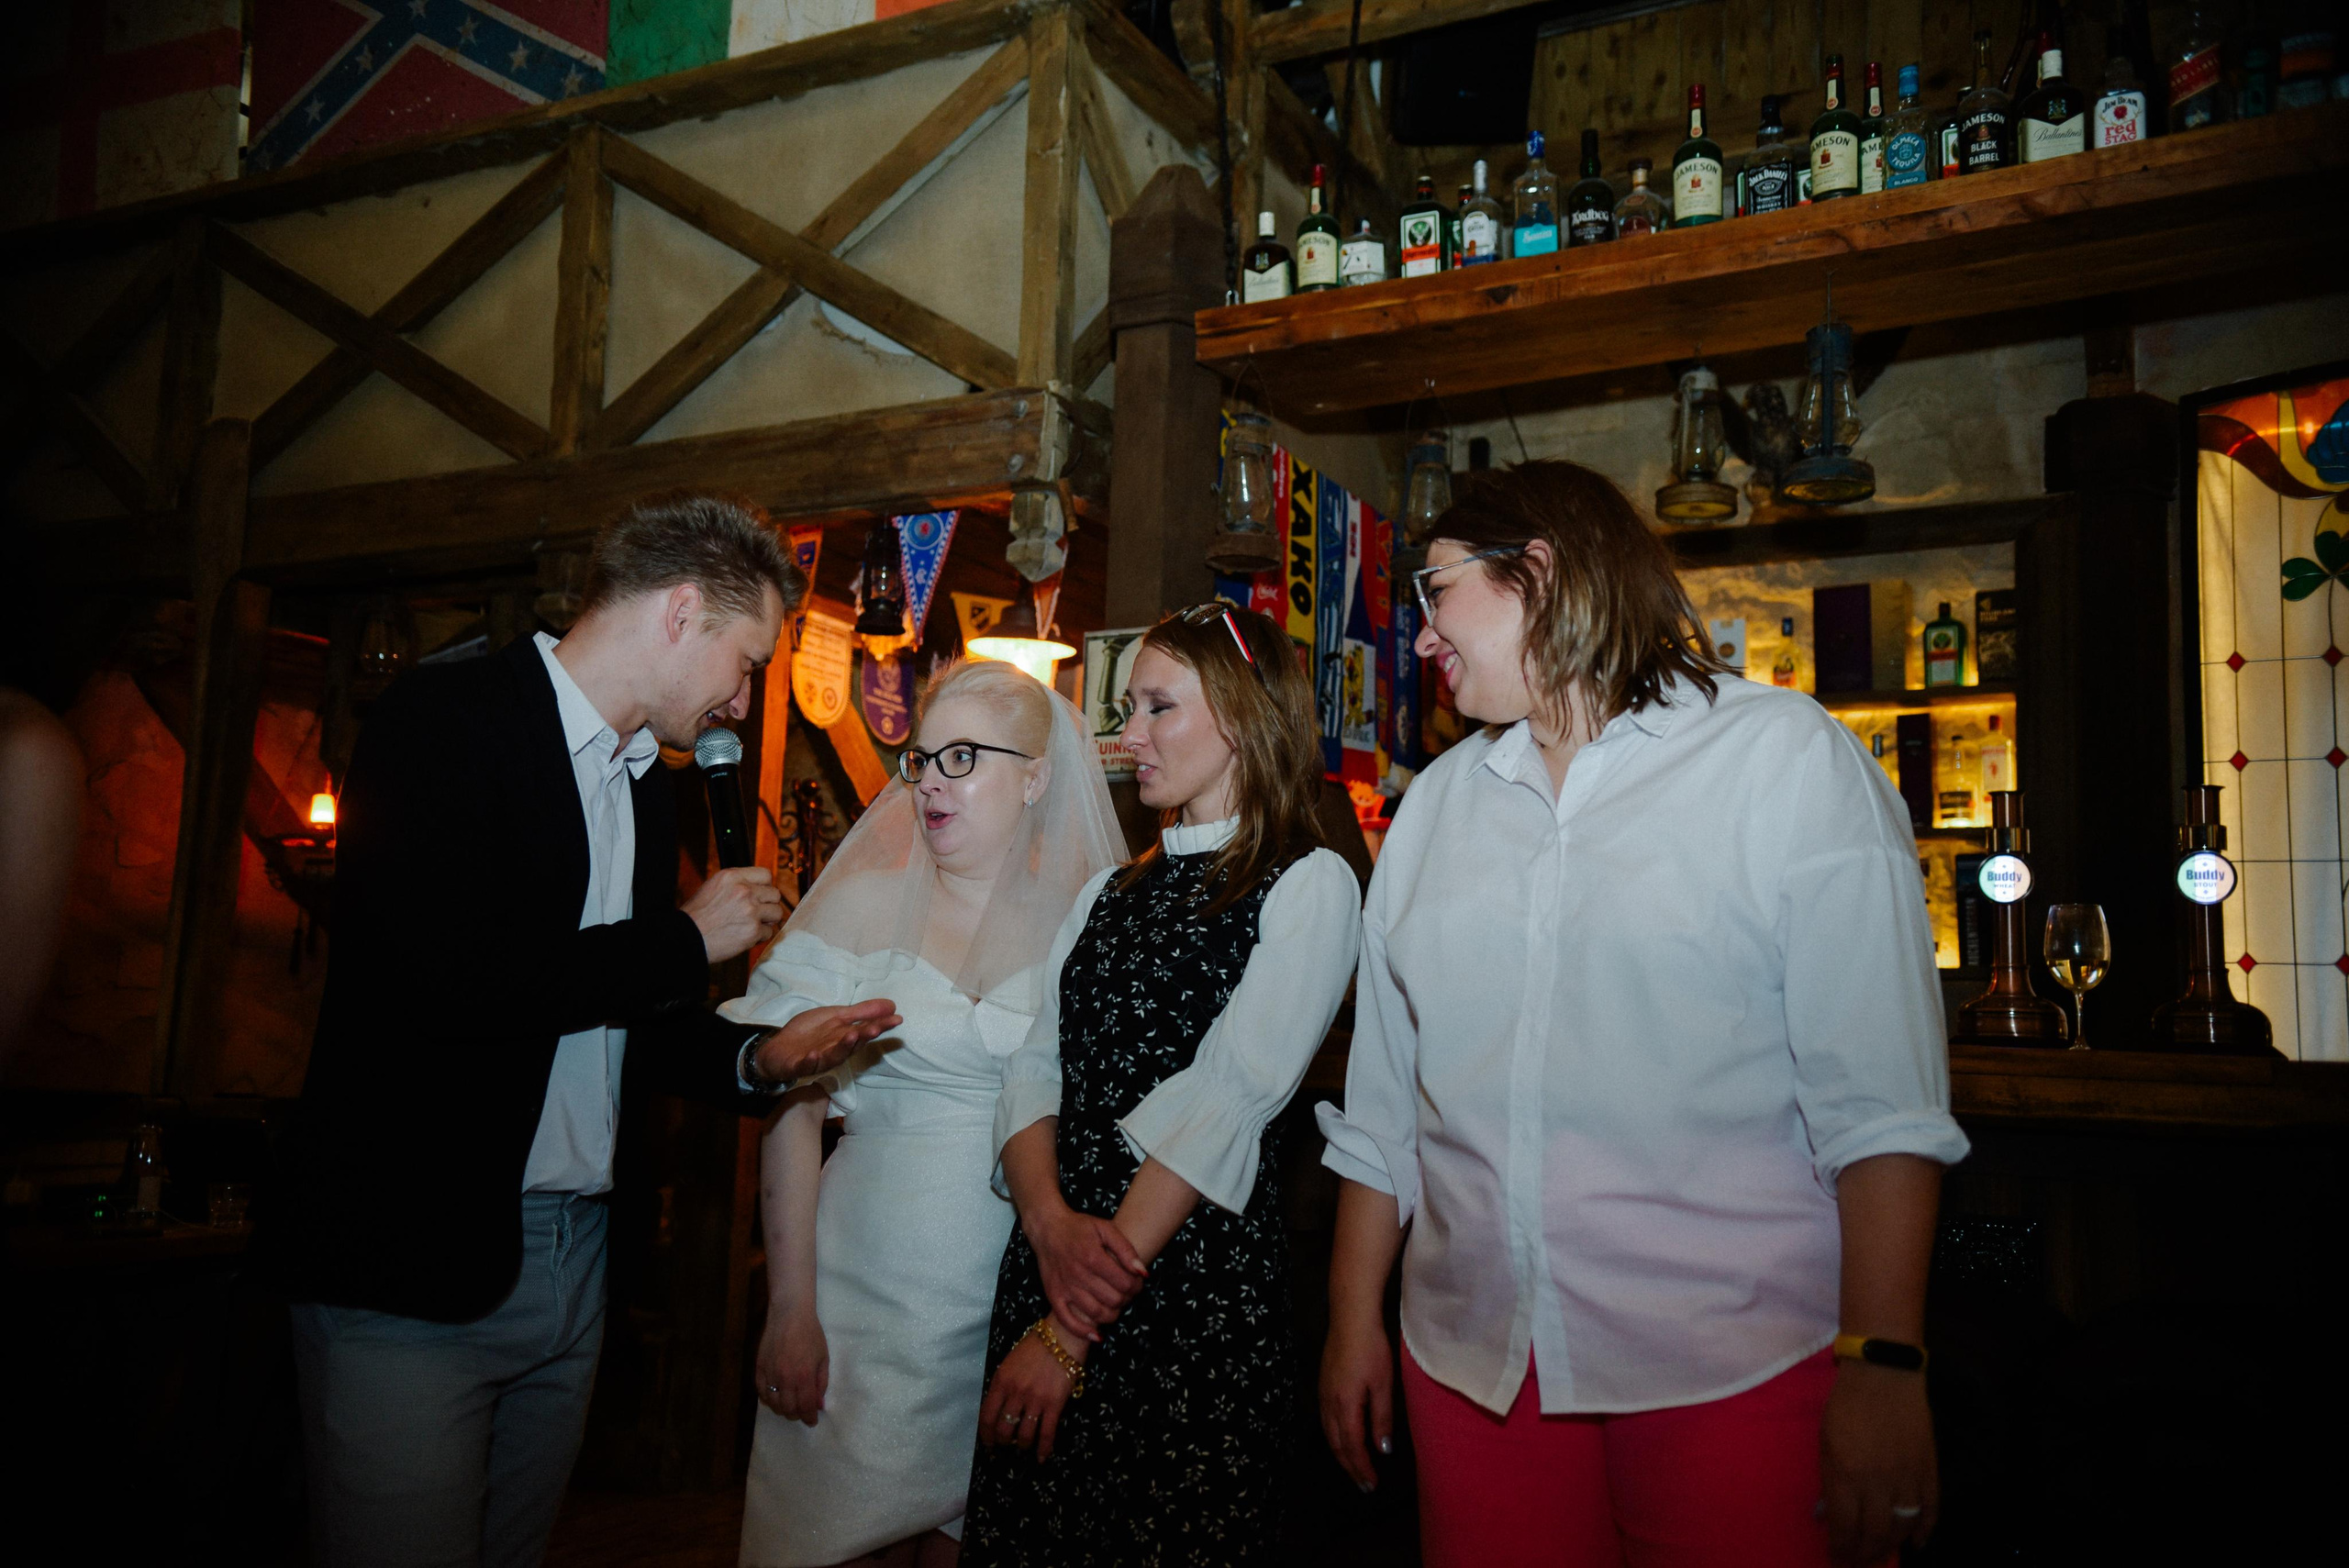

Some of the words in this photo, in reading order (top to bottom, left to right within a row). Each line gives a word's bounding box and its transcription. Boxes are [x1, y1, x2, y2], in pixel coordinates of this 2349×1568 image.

[2102, 100, 2116, 113] JIM
[2117, 96, 2138, 106] BEAM
[1961, 112, 2007, 133] JAMESON
[2105, 118, 2136, 136] red
[1811, 135, 1851, 152] AMESON
[1891, 135, 1920, 150] OLMECA
[1970, 139, 1998, 153] BLACK
[2105, 133, 2137, 145] STAG
[1891, 152, 1921, 168] TEQUILA
[1968, 151, 2000, 166] BARREL
[1675, 161, 1719, 181] JAMESON
[1893, 176, 1919, 185] BLANCO
[1987, 871, 2022, 883] Buddy
[2186, 869, 2225, 882] Buddy
